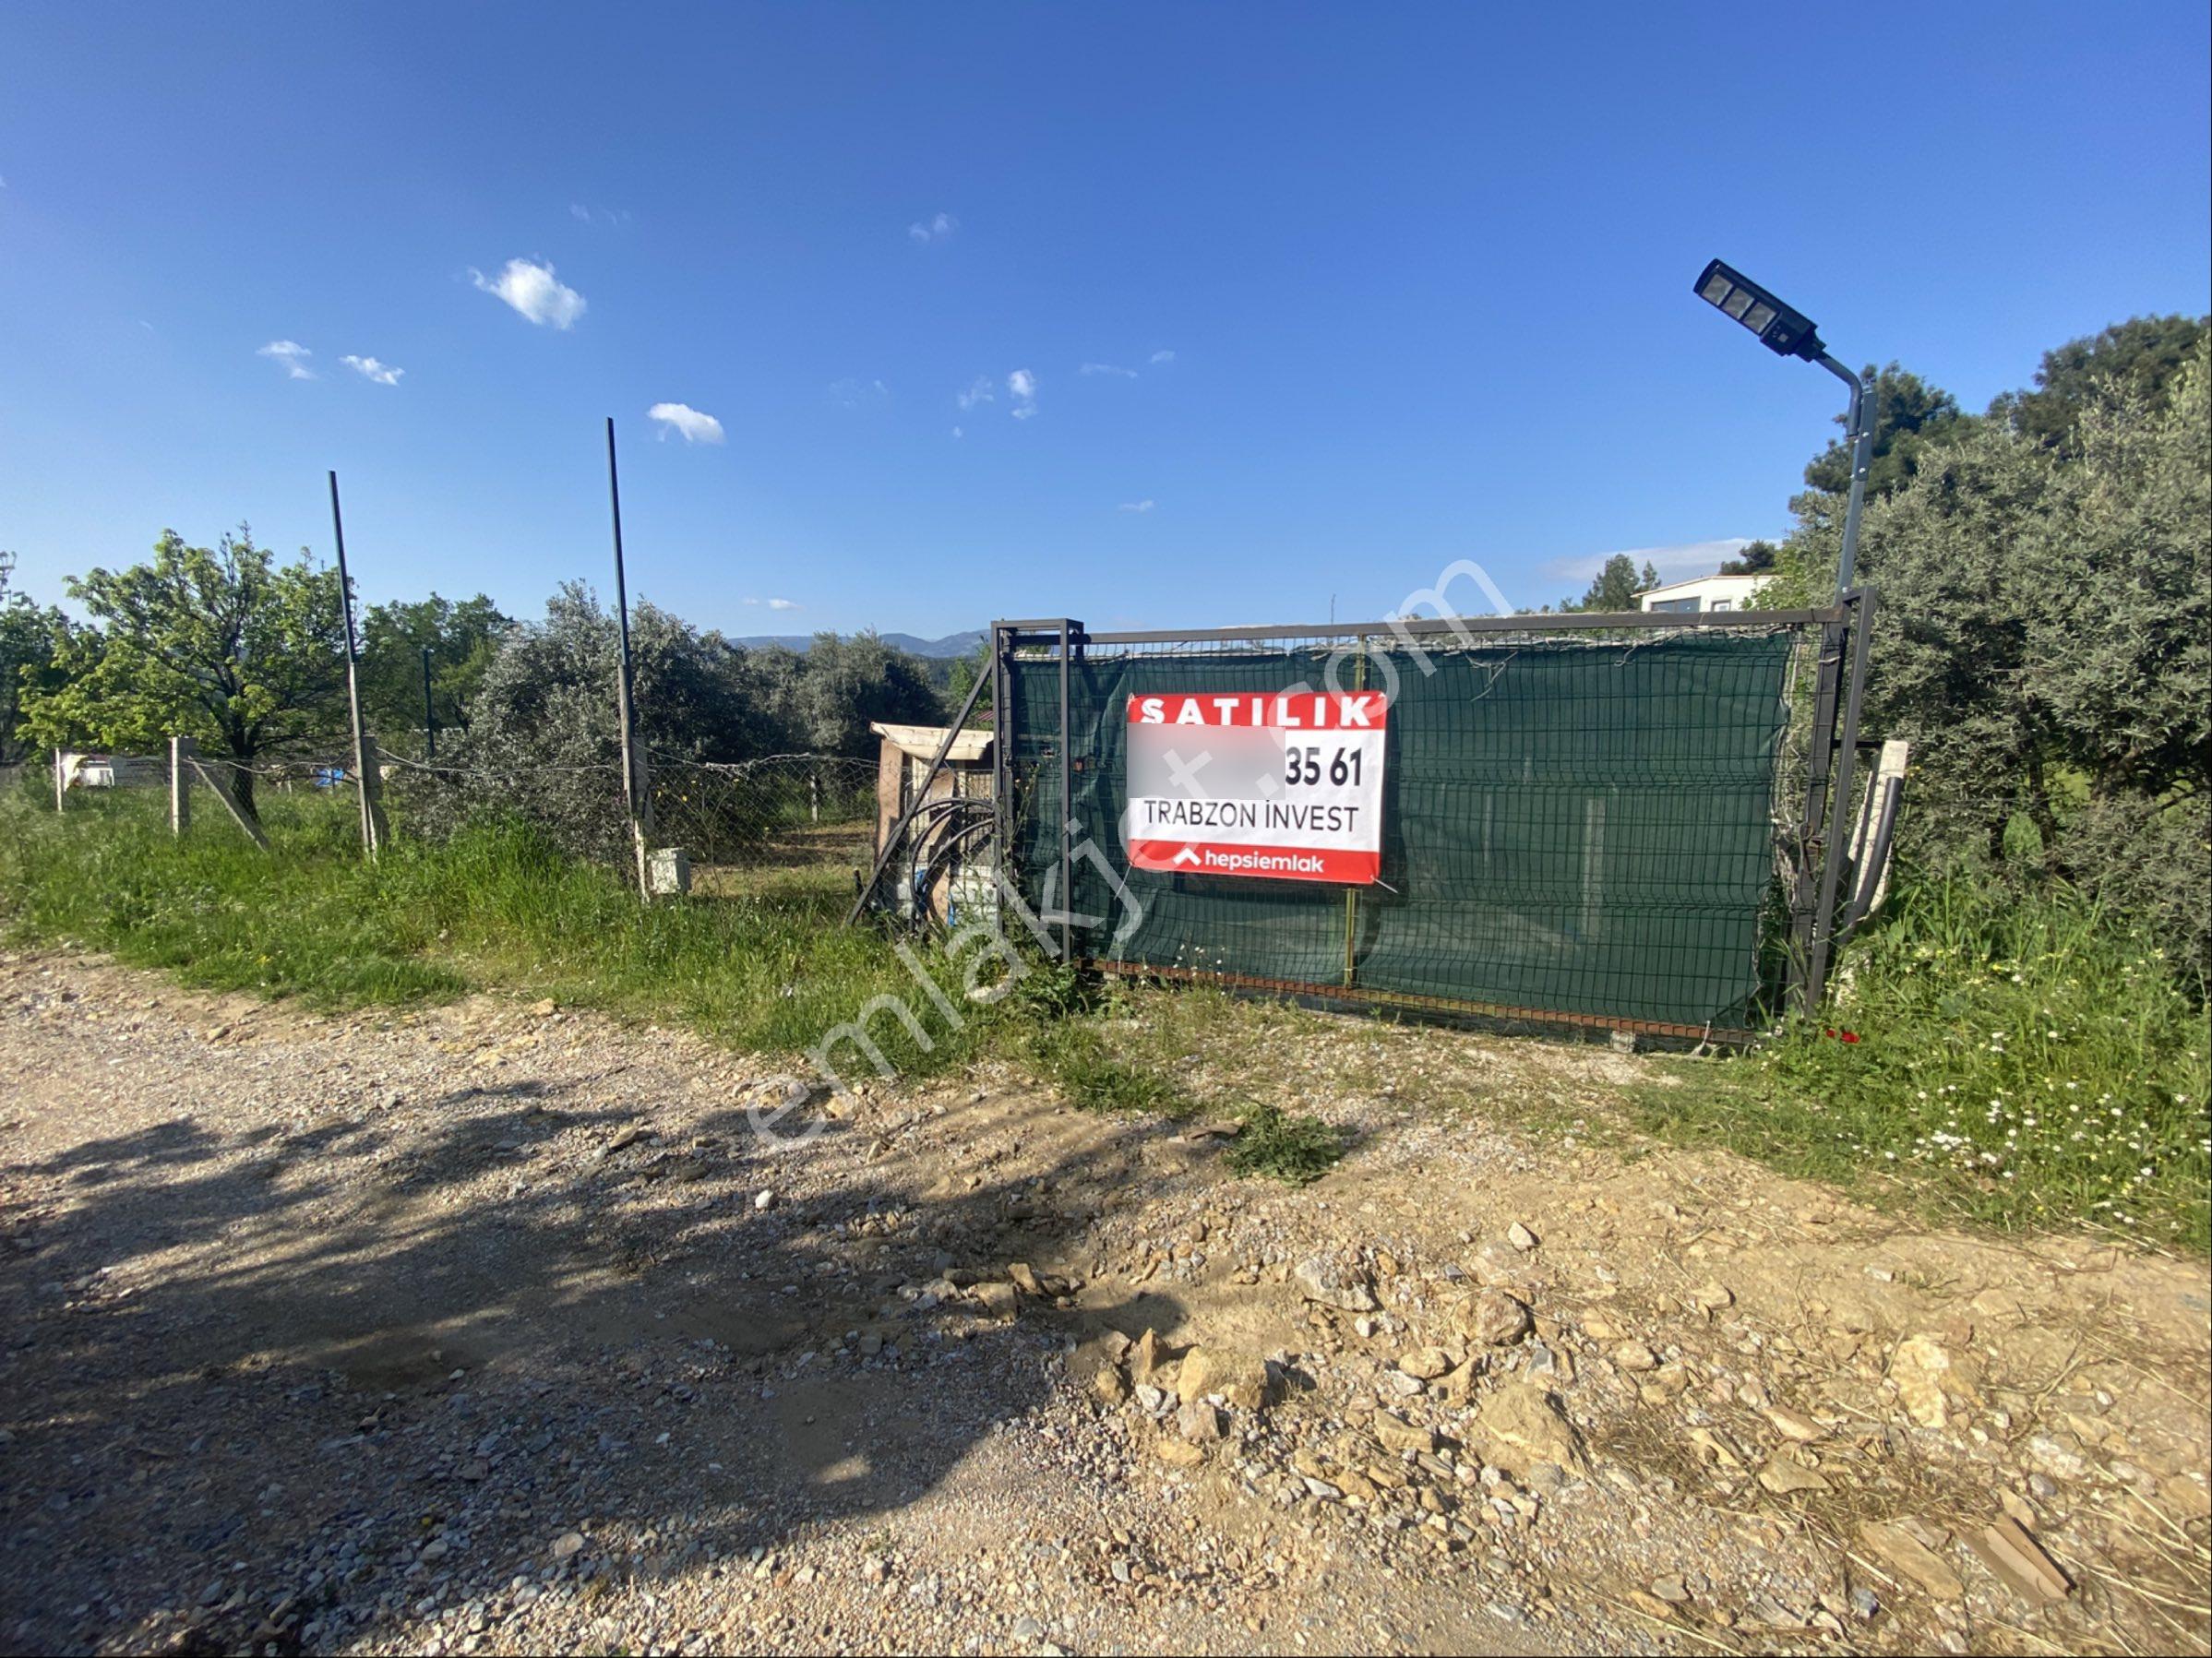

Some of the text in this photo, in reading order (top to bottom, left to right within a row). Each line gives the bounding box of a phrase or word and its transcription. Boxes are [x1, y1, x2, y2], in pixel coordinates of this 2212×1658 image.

[1140, 696, 1371, 727] SATILIK
[1285, 746, 1362, 787] 35 61
[1144, 799, 1359, 832] TRABZON İNVEST
[1204, 849, 1324, 873] hepsiemlak
